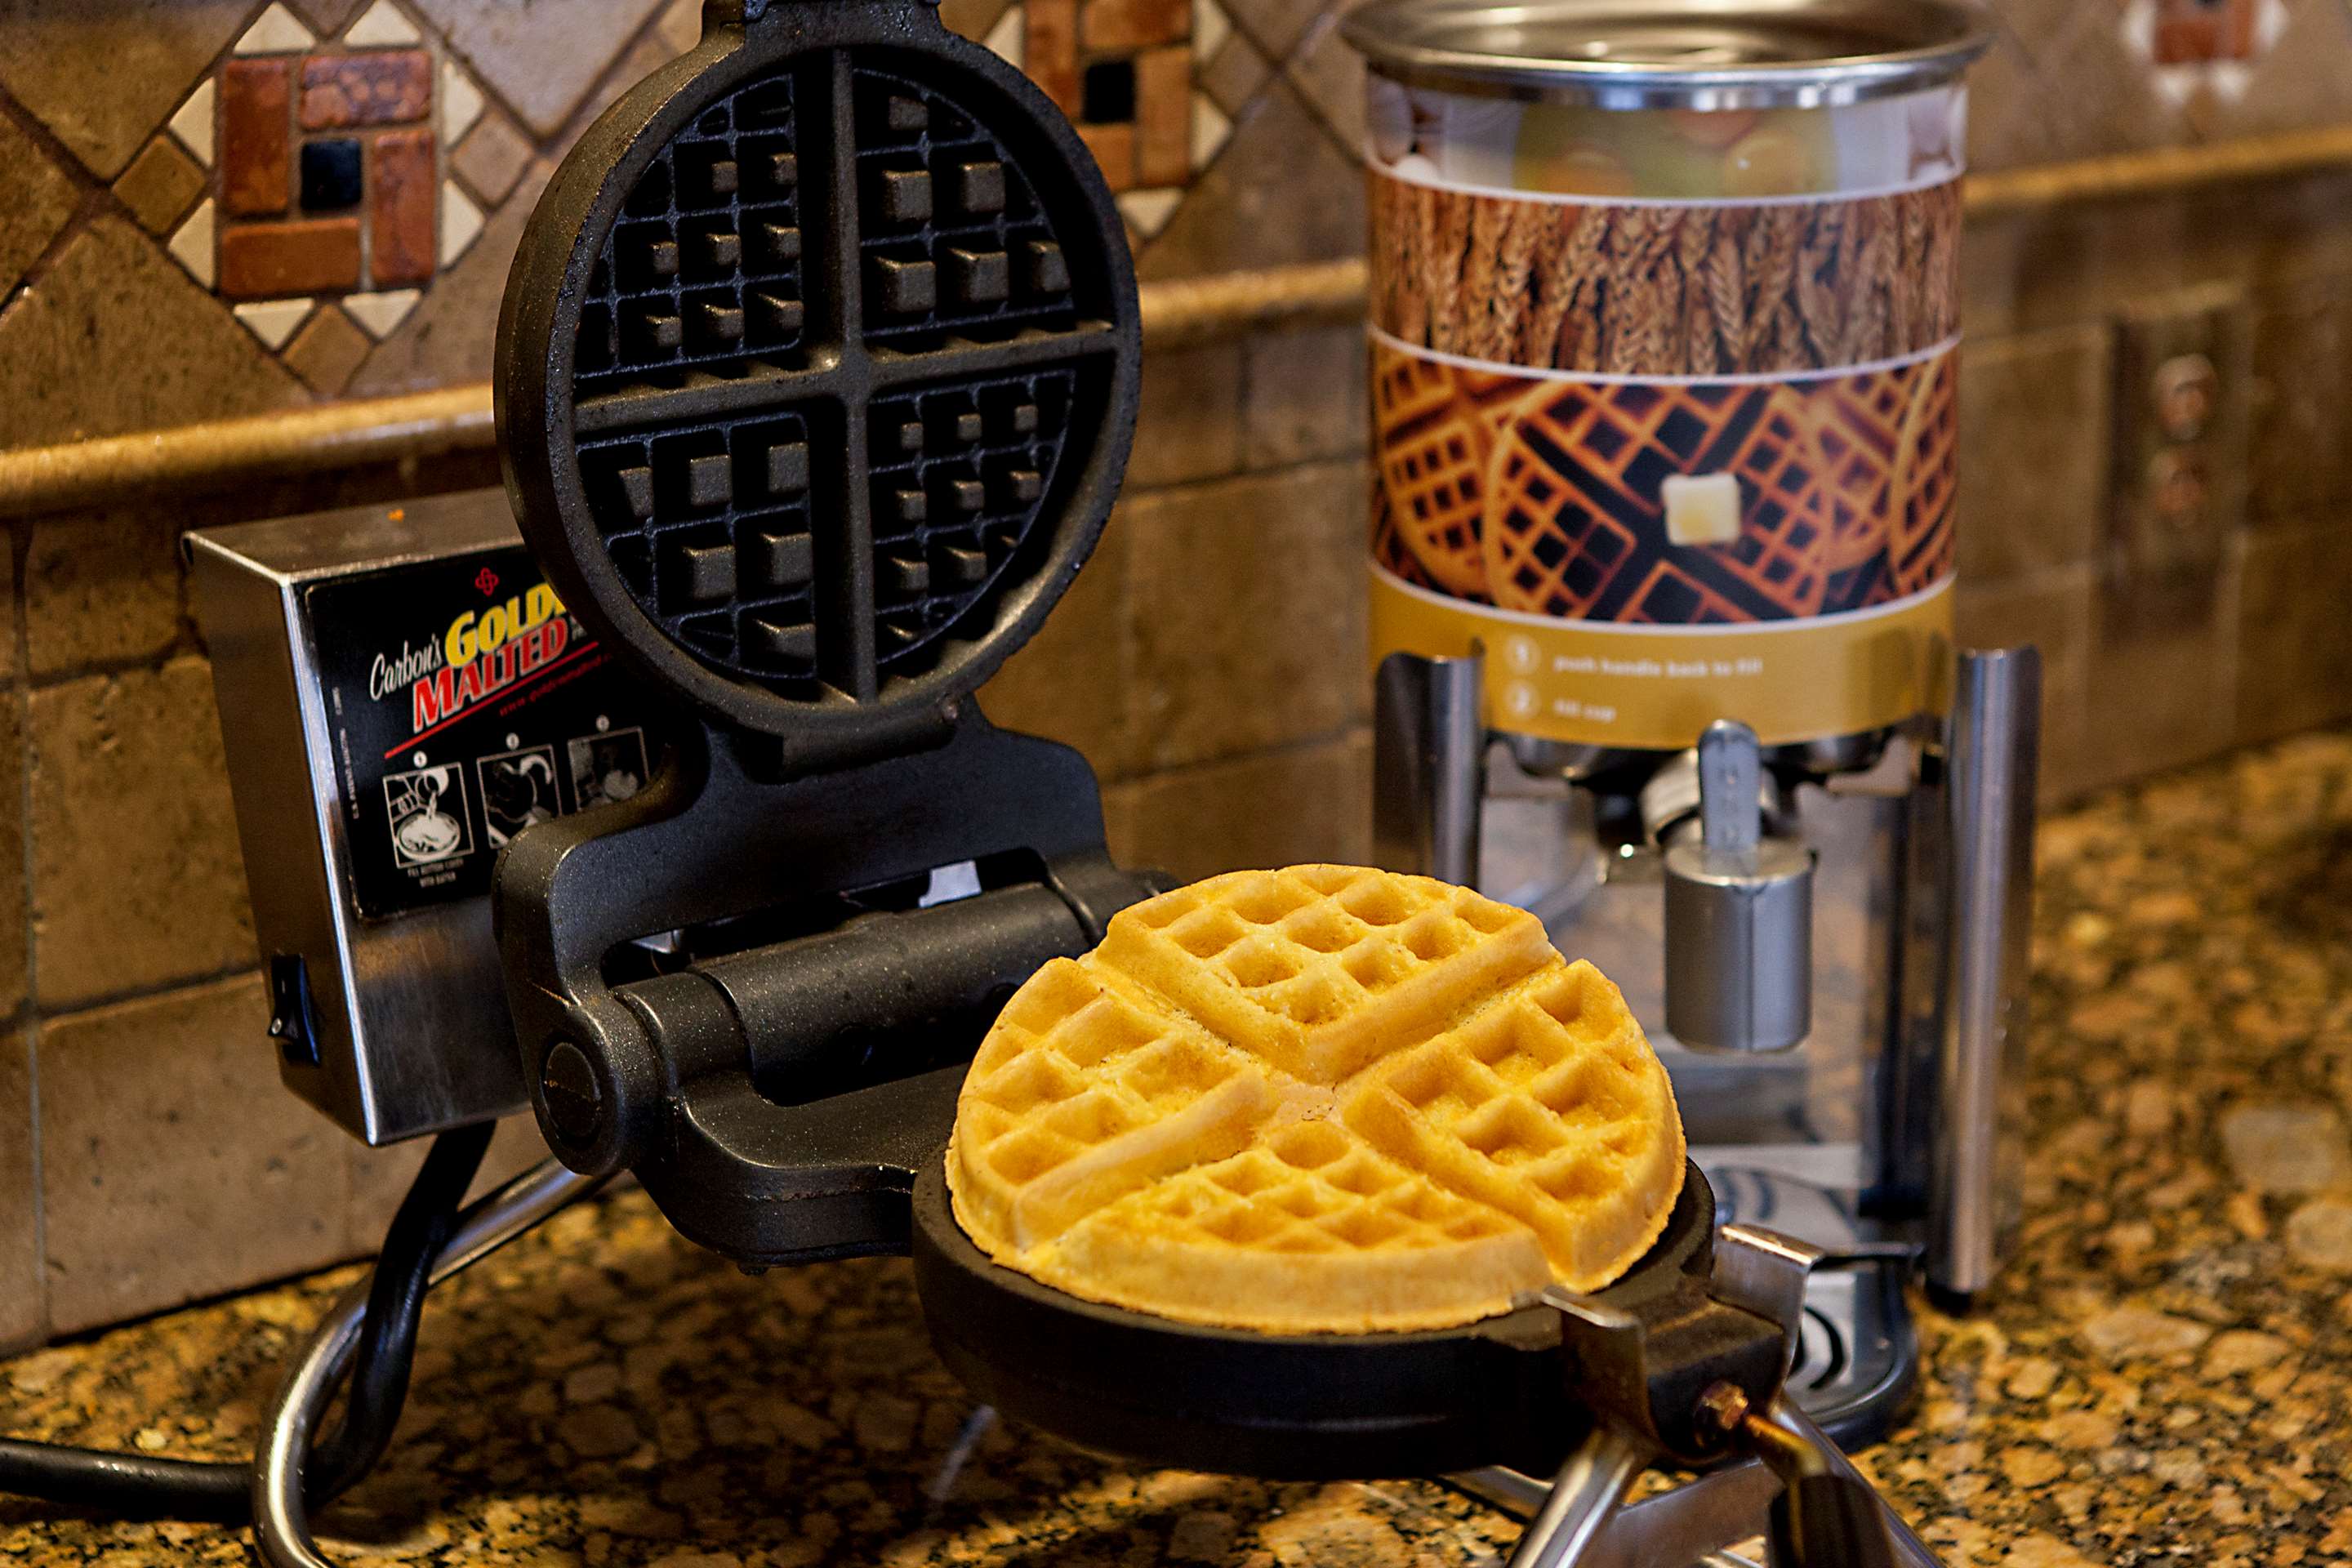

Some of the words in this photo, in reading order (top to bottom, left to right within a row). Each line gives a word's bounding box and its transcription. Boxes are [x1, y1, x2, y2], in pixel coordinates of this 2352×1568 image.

[369, 633, 443, 701] Carbon's
[413, 617, 569, 734] MALTED
[1601, 657, 1661, 676] handle
